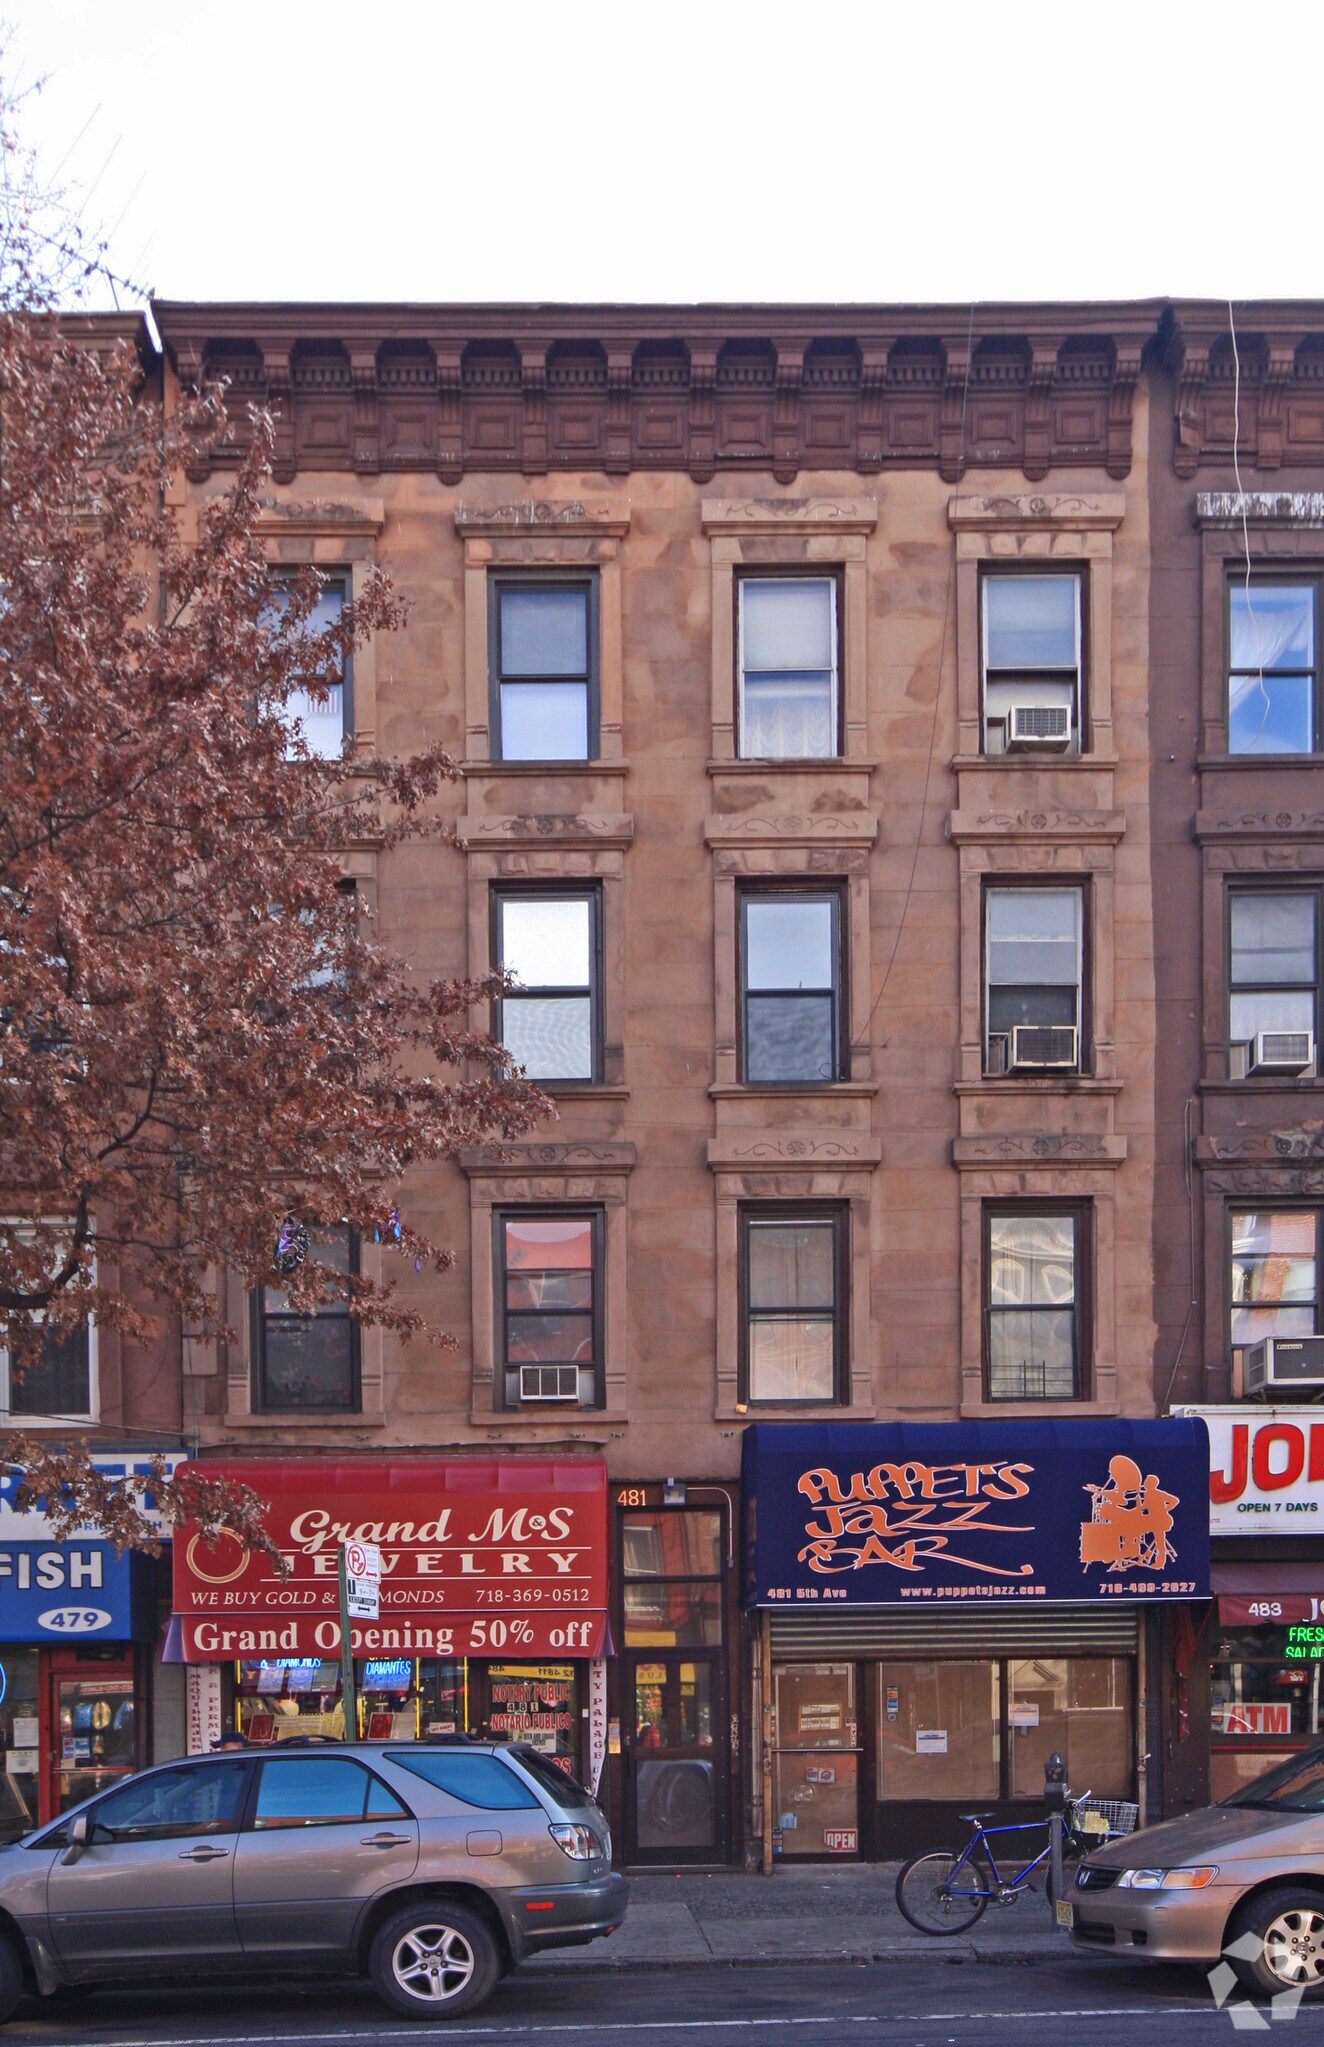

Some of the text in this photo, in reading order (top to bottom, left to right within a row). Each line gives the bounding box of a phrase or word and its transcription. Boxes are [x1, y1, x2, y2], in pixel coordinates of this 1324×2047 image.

[797, 1461, 1034, 1504] PUPPETS
[617, 1489, 647, 1507] 481
[1237, 1502, 1319, 1513] OPEN 7 DAYS
[289, 1509, 452, 1554] Grand
[797, 1534, 1034, 1576] BAR
[0, 1551, 103, 1589] FISH
[191, 1589, 589, 1605] WE BUY GOLD & MONDS 718-369-0512
[767, 1588, 847, 1598] 481 5th Ave
[900, 1585, 1047, 1597] www.puppetsjazz.com
[1248, 1603, 1282, 1616] 483
[50, 1612, 99, 1628] 479
[194, 1619, 593, 1655] Grand Opening 50% off
[1289, 1627, 1324, 1641] FRES
[366, 1660, 411, 1675] DIAMANTES
[492, 1683, 570, 1702] NOTARY PUBLIC
[491, 1712, 572, 1730] NOTARIO PUBLICO
[1226, 1705, 1289, 1733] ATM
[826, 1832, 856, 1849] OPEN
